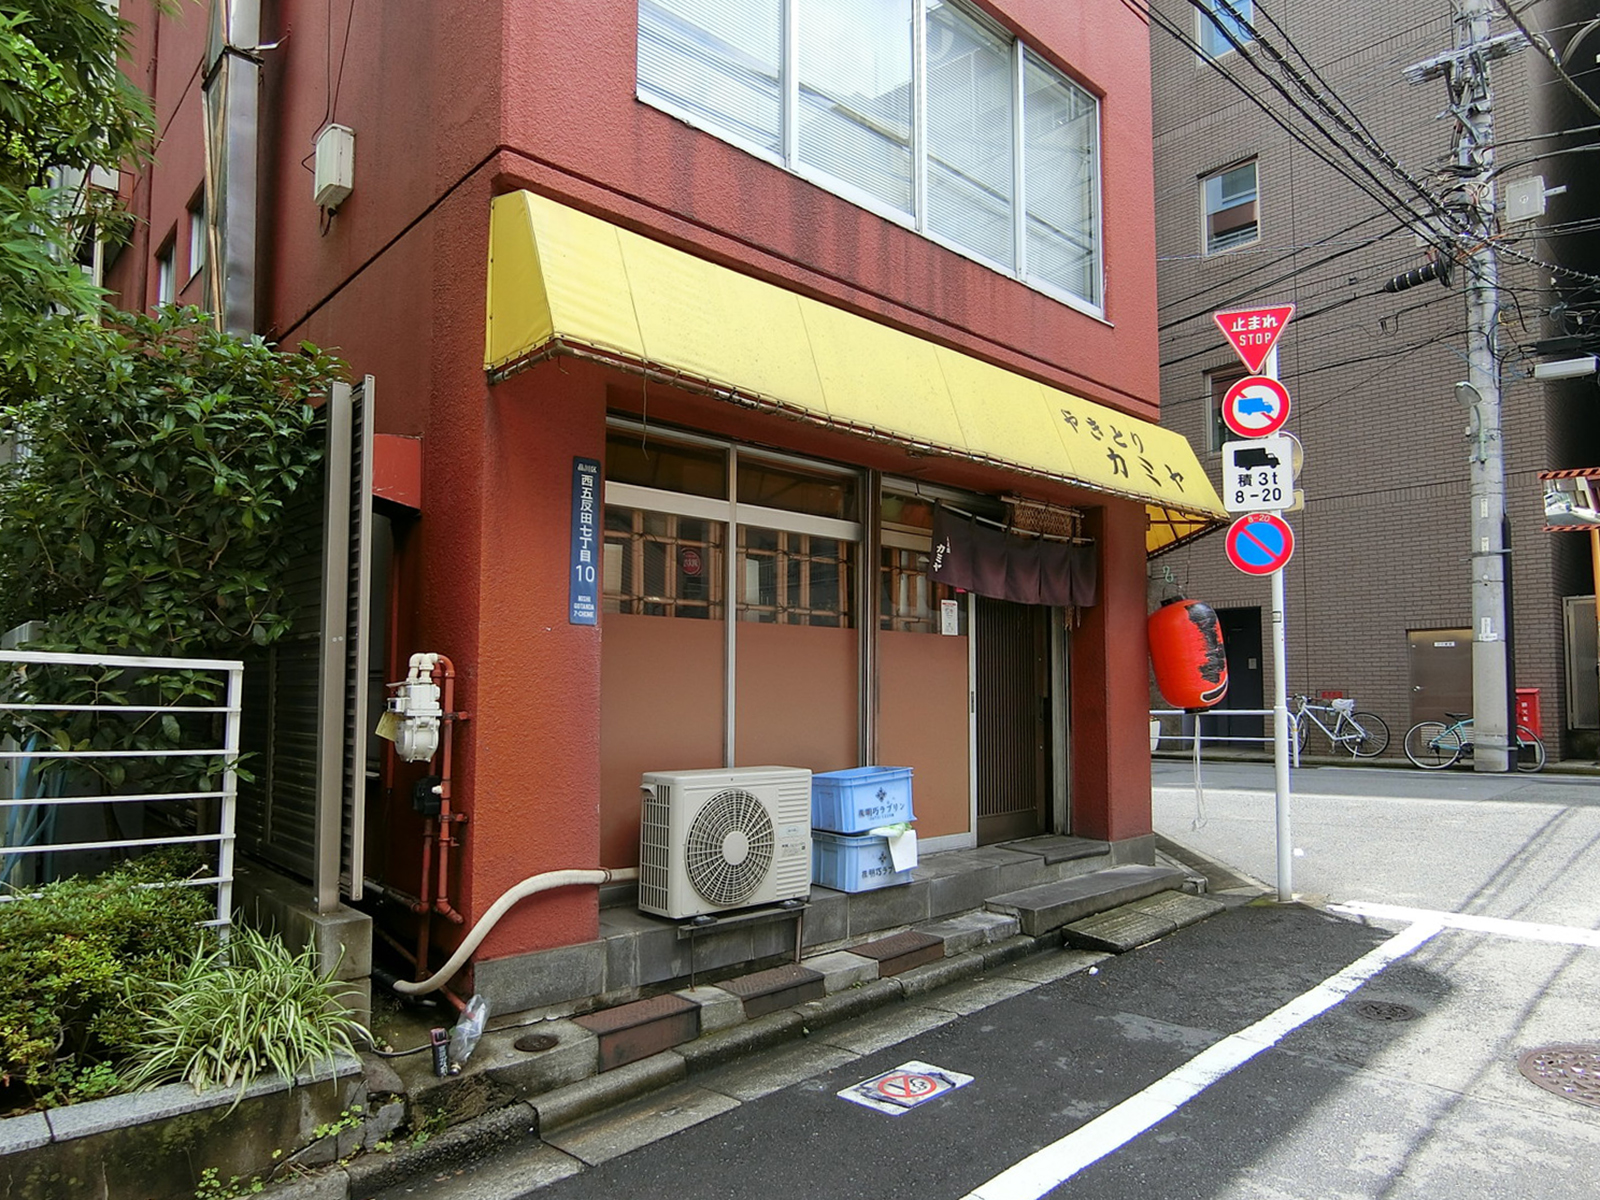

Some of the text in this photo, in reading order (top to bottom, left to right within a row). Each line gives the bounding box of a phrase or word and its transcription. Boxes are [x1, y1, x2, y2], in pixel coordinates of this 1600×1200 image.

[1230, 314, 1279, 332] 止まれ
[1239, 332, 1272, 347] STOP
[1060, 408, 1145, 454] やきとり
[1106, 446, 1185, 493] カミヤ
[1235, 487, 1282, 504] 8-20
[579, 474, 594, 563] 西五反田七丁目
[575, 564, 596, 583] 10
